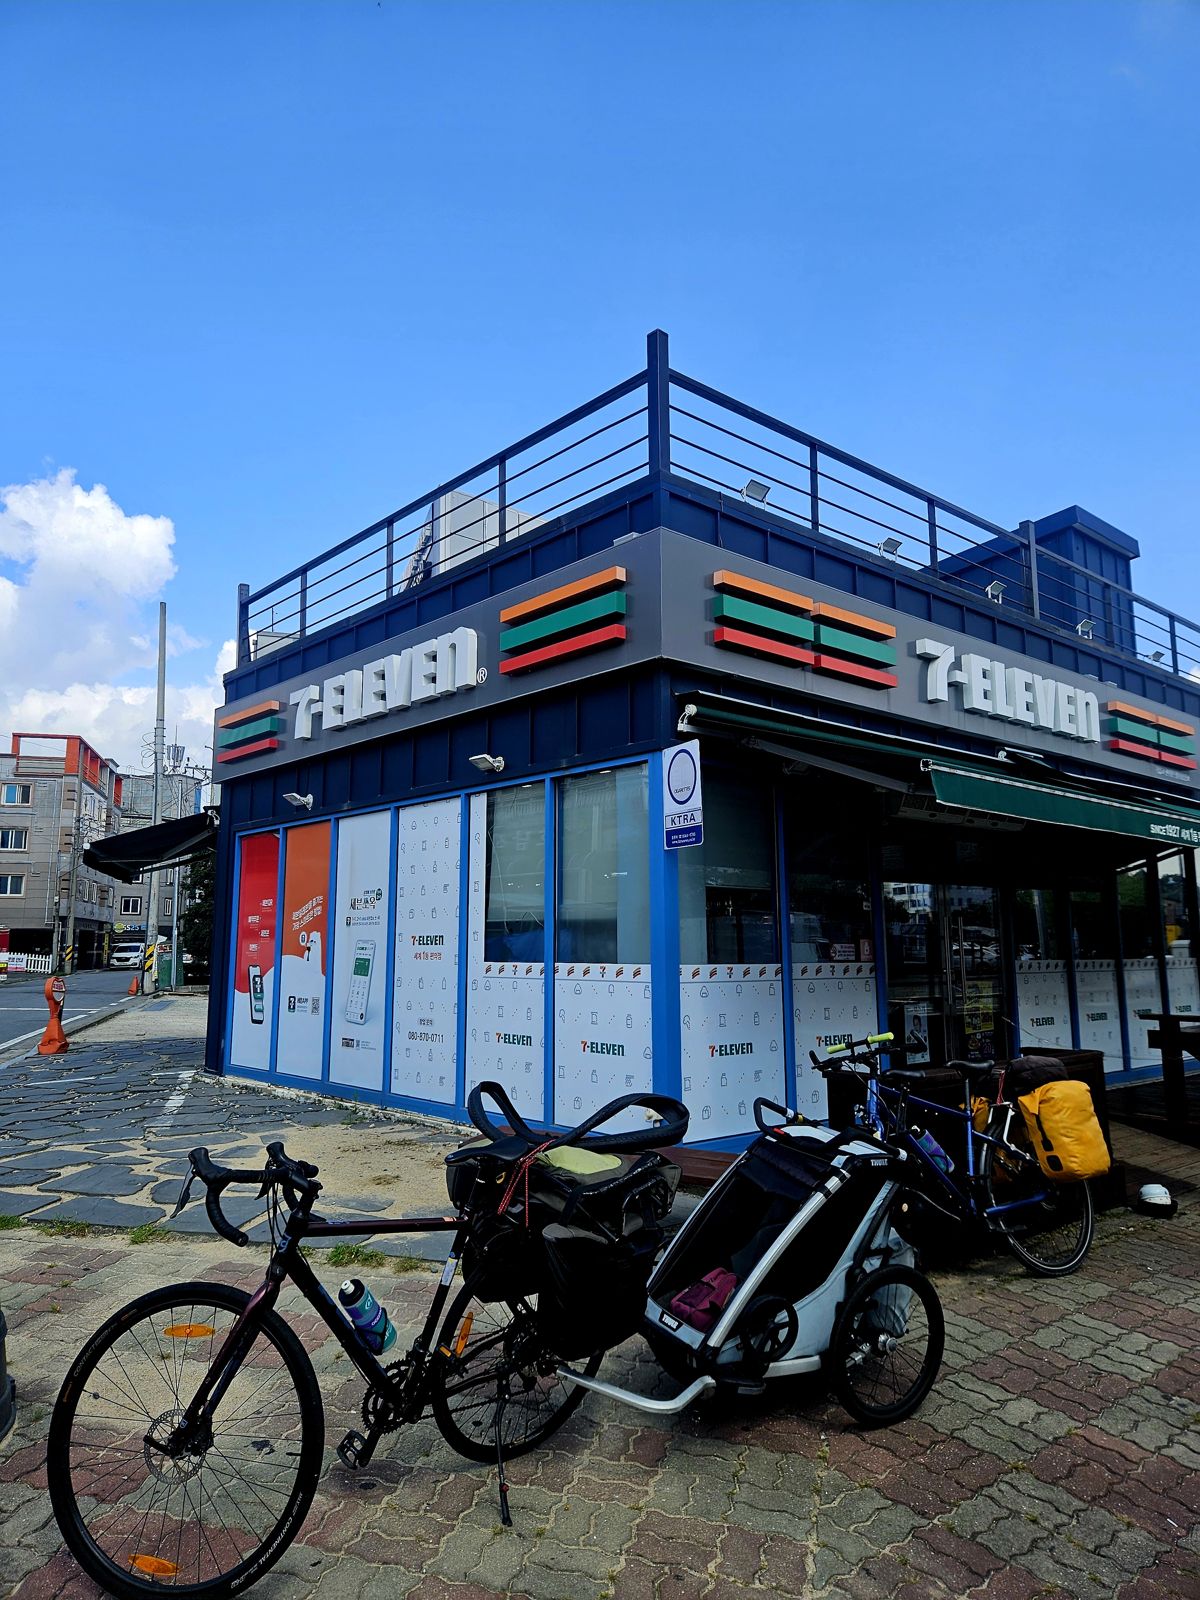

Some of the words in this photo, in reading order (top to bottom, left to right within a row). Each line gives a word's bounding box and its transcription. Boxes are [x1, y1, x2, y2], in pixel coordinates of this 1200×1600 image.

[670, 812, 696, 826] KTRA
[408, 1031, 444, 1043] 080-870-0711
[259, 1517, 294, 1565] CONTINENTAL
